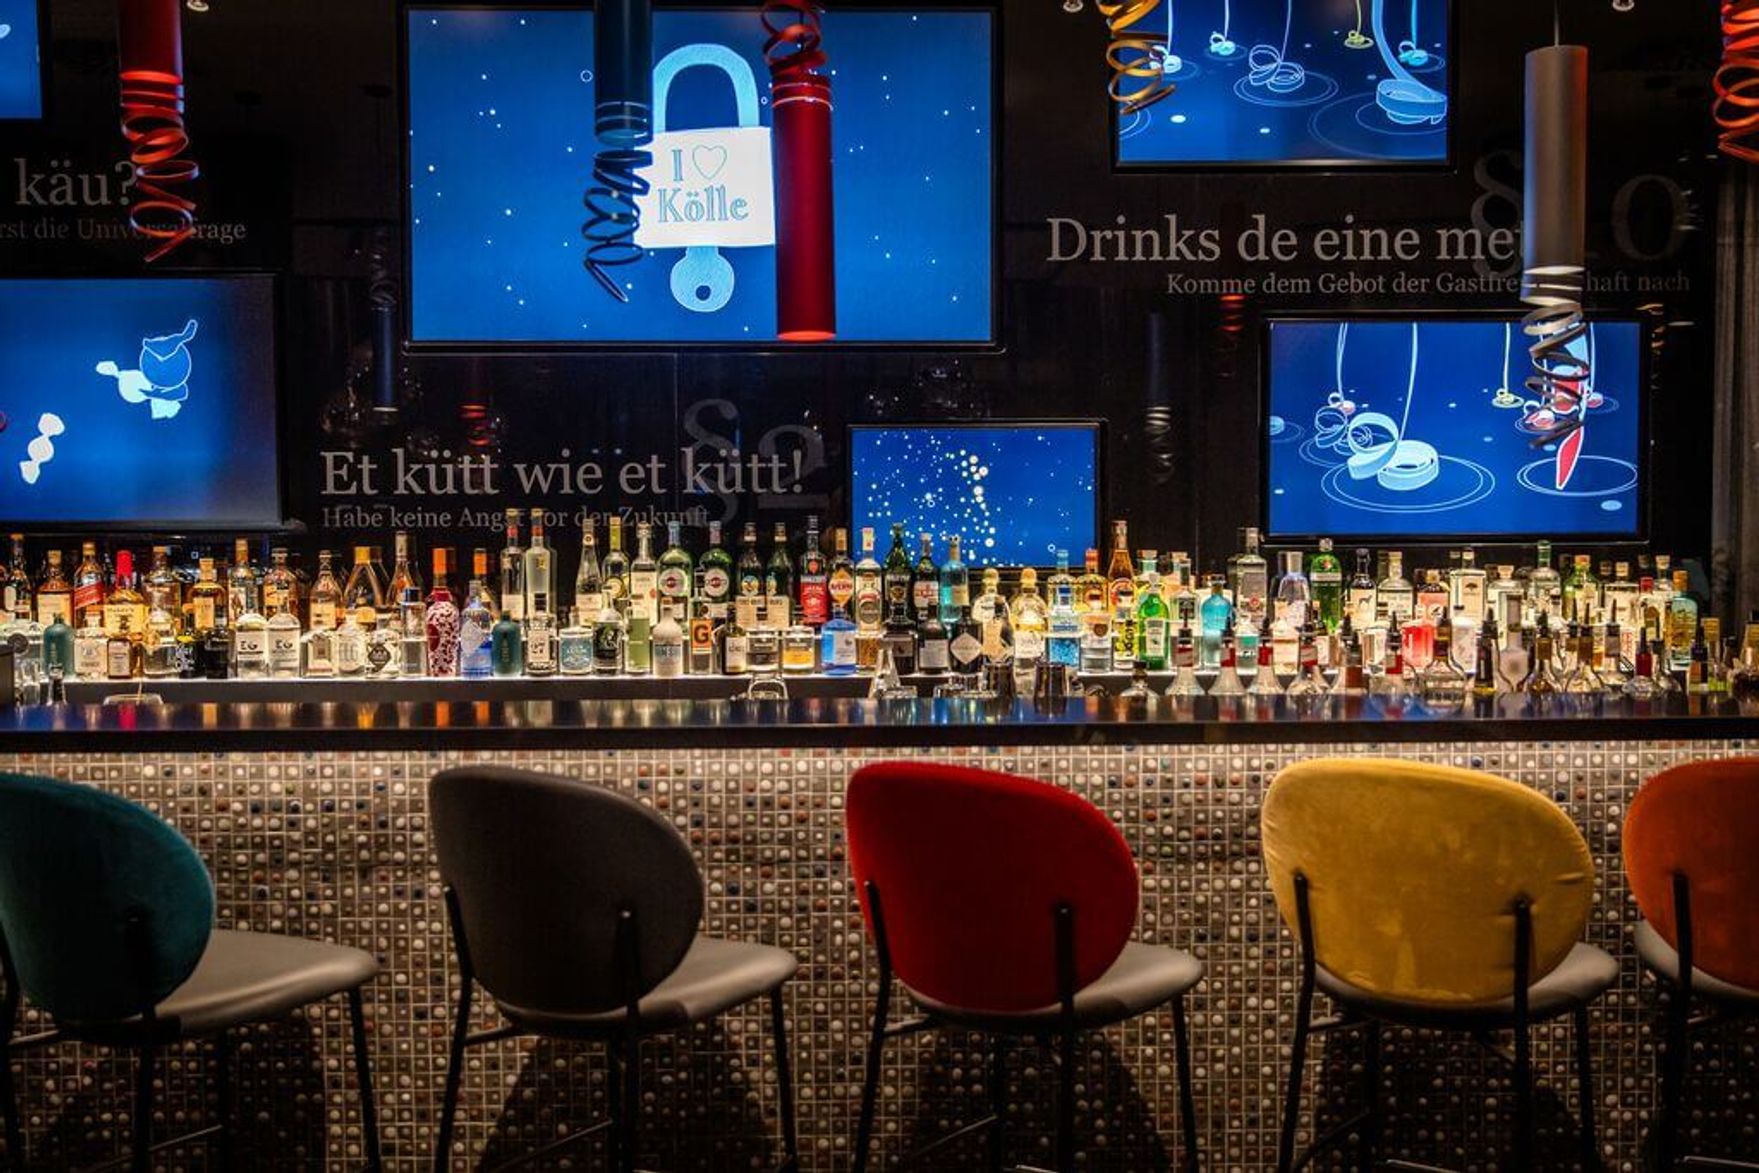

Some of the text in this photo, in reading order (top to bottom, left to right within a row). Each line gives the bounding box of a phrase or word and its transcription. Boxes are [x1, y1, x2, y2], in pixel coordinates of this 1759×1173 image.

[13, 157, 137, 206] käu?
[672, 149, 684, 182] I
[658, 185, 749, 223] Kölle
[33, 217, 70, 239] die
[77, 217, 247, 245] Univrlrage
[1046, 213, 1221, 262] Drinks
[1237, 213, 1298, 261] de
[1313, 213, 1421, 261] eine
[1167, 271, 1691, 294] Komme dem Gebot der Gastfrehaft nach
[320, 447, 804, 496] Et kütt wie et kütt!
[321, 506, 384, 528] Habe
[391, 506, 451, 528] keine
[459, 507, 525, 533] Angt
[694, 624, 709, 644] G
